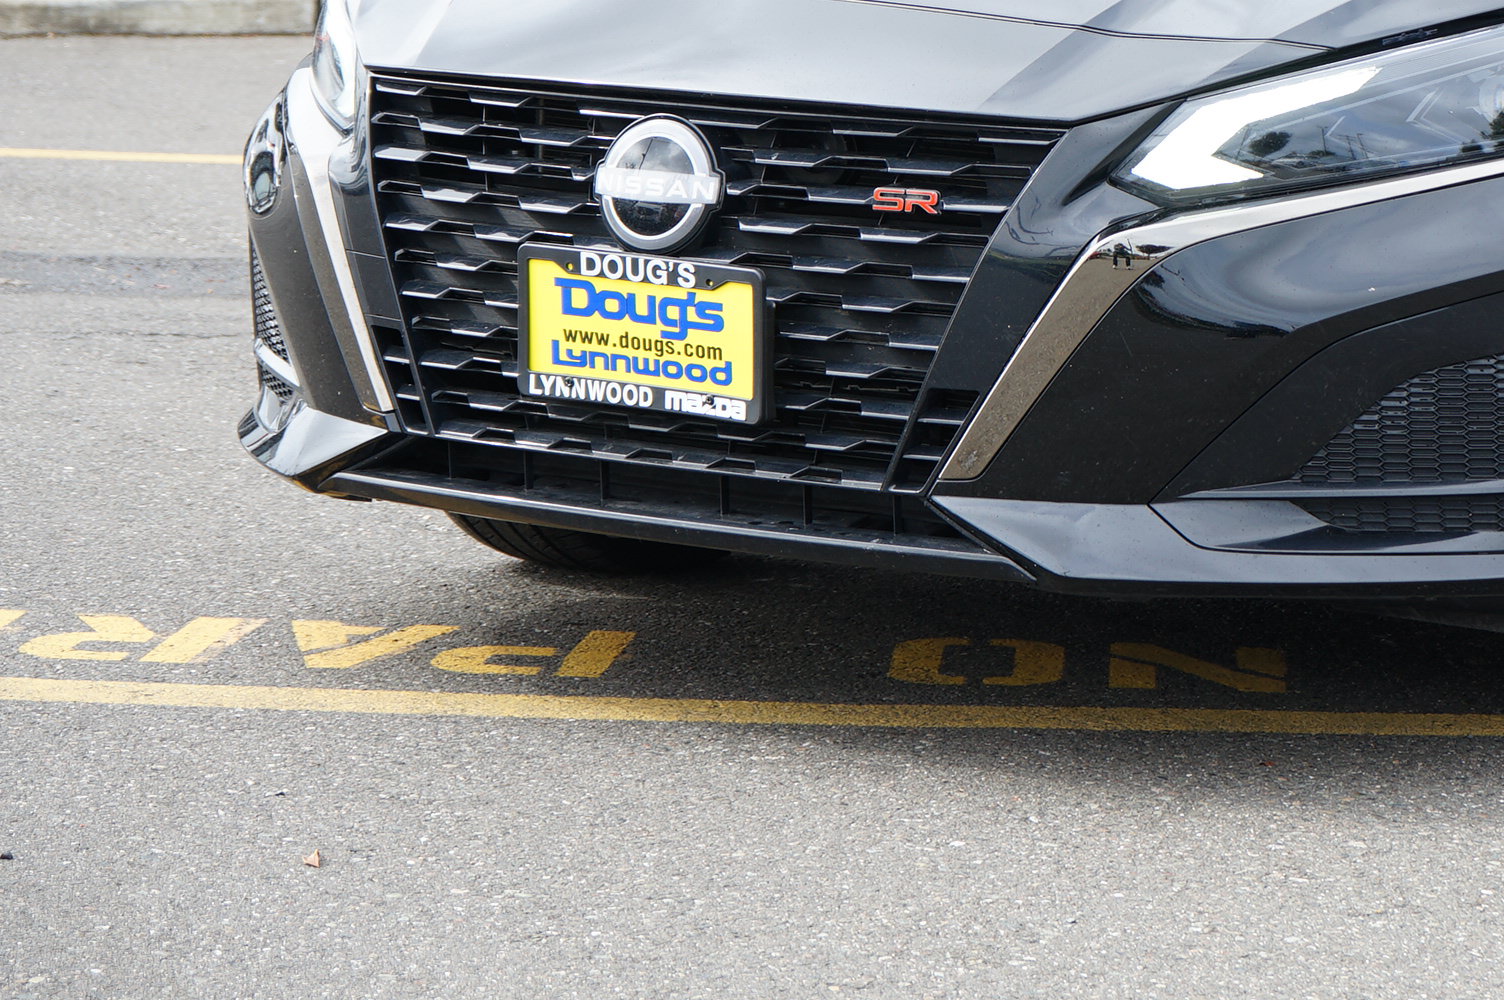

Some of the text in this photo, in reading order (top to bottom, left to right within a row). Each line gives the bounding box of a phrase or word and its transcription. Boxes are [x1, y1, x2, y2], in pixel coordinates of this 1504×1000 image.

[599, 174, 716, 201] NISSAN
[872, 187, 938, 214] SR
[580, 252, 696, 289] DOUG'S
[563, 328, 723, 361] www.dougs.com
[551, 340, 733, 386] Lynnwood
[529, 373, 654, 408] LYNNWOOD
[0, 609, 636, 678] PAR
[887, 637, 1287, 694] NO
